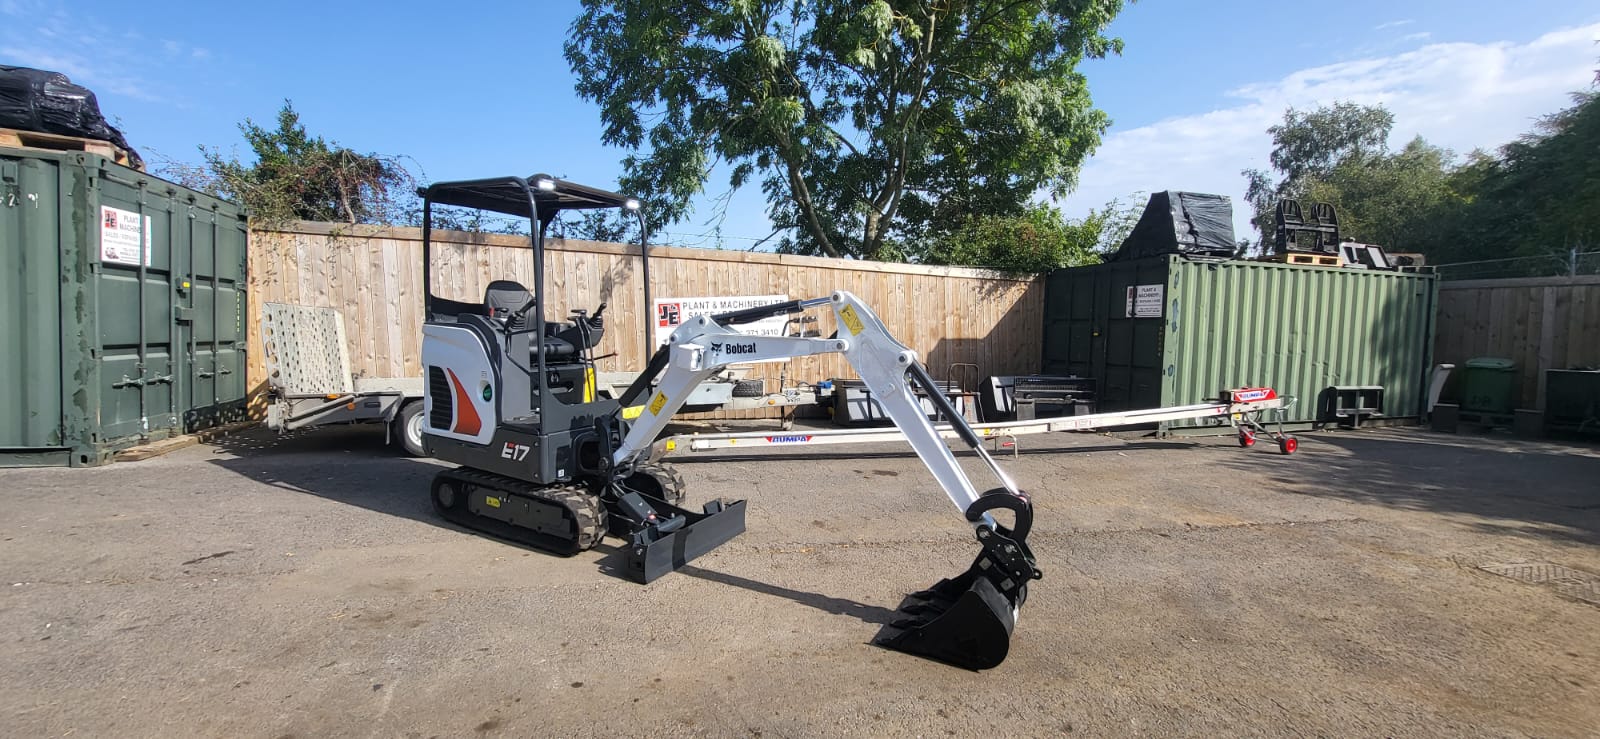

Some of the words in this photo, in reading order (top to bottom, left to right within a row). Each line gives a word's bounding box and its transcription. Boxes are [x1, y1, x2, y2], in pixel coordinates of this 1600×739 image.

[682, 301, 709, 311] PLANT
[712, 301, 718, 309] &
[720, 299, 768, 309] MACHINERY
[725, 342, 757, 354] Bobcat
[501, 441, 530, 461] E17
